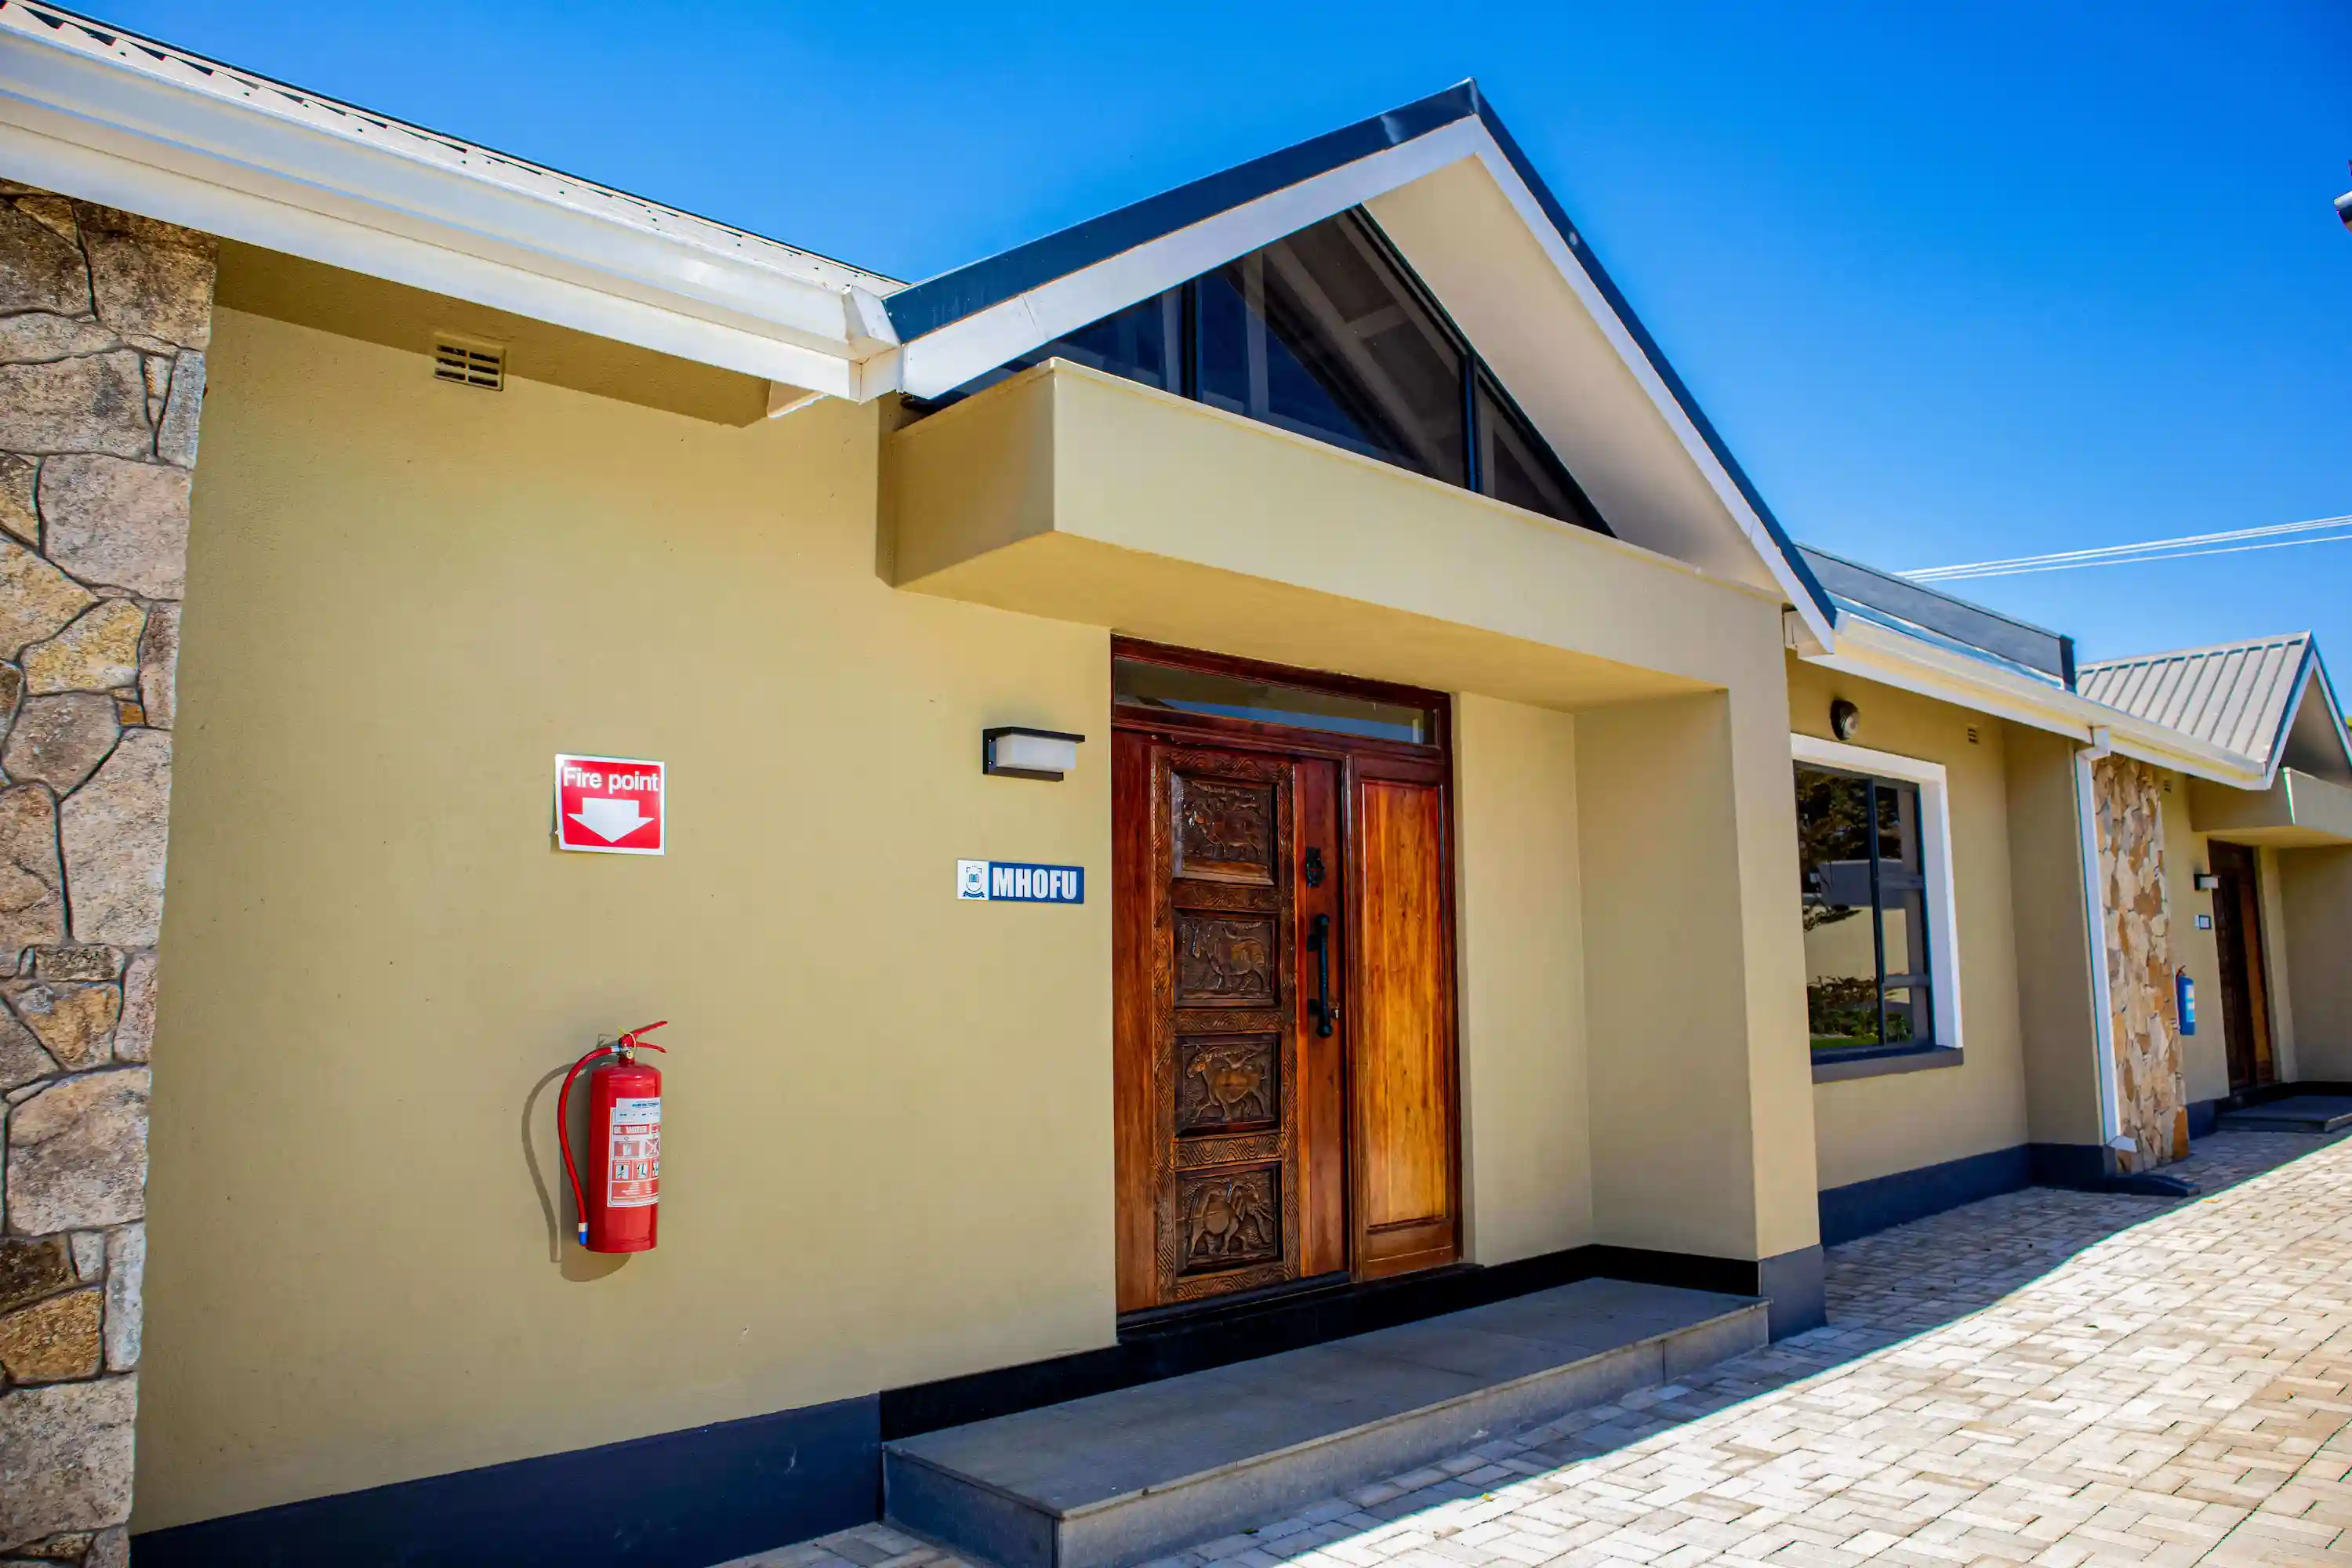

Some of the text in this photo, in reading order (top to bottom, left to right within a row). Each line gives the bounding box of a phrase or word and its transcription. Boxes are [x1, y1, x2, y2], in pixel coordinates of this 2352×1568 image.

[564, 766, 659, 794] Fire point
[993, 867, 1077, 899] MHOFU
